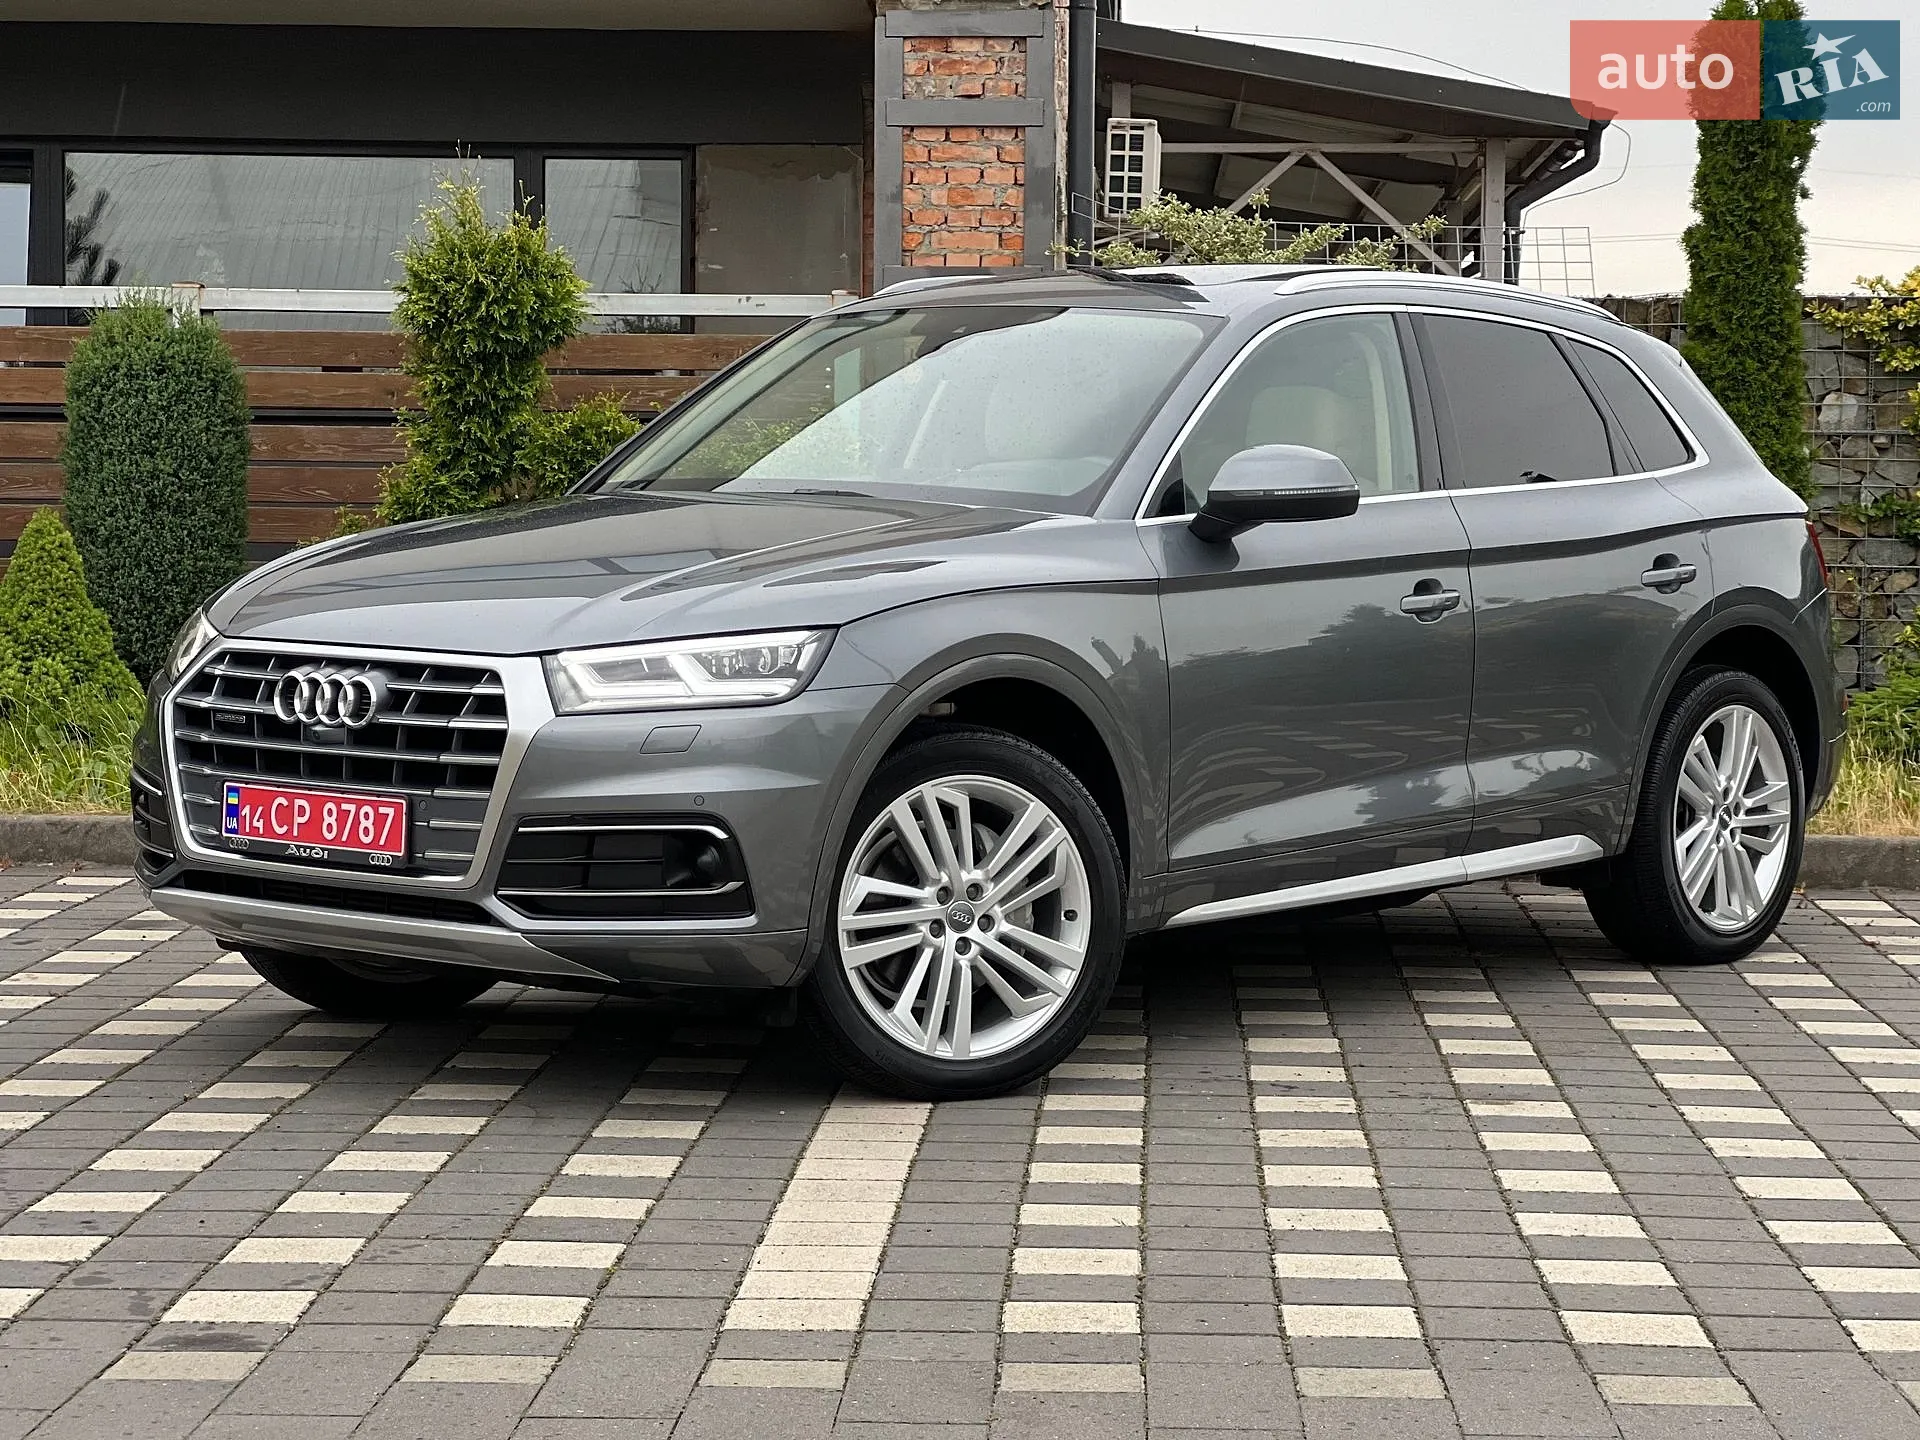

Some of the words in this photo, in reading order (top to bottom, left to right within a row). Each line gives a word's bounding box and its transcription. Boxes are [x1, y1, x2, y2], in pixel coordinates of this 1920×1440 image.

[226, 816, 238, 830] UA
[321, 801, 395, 846] 8787
[285, 844, 329, 859] Audi
